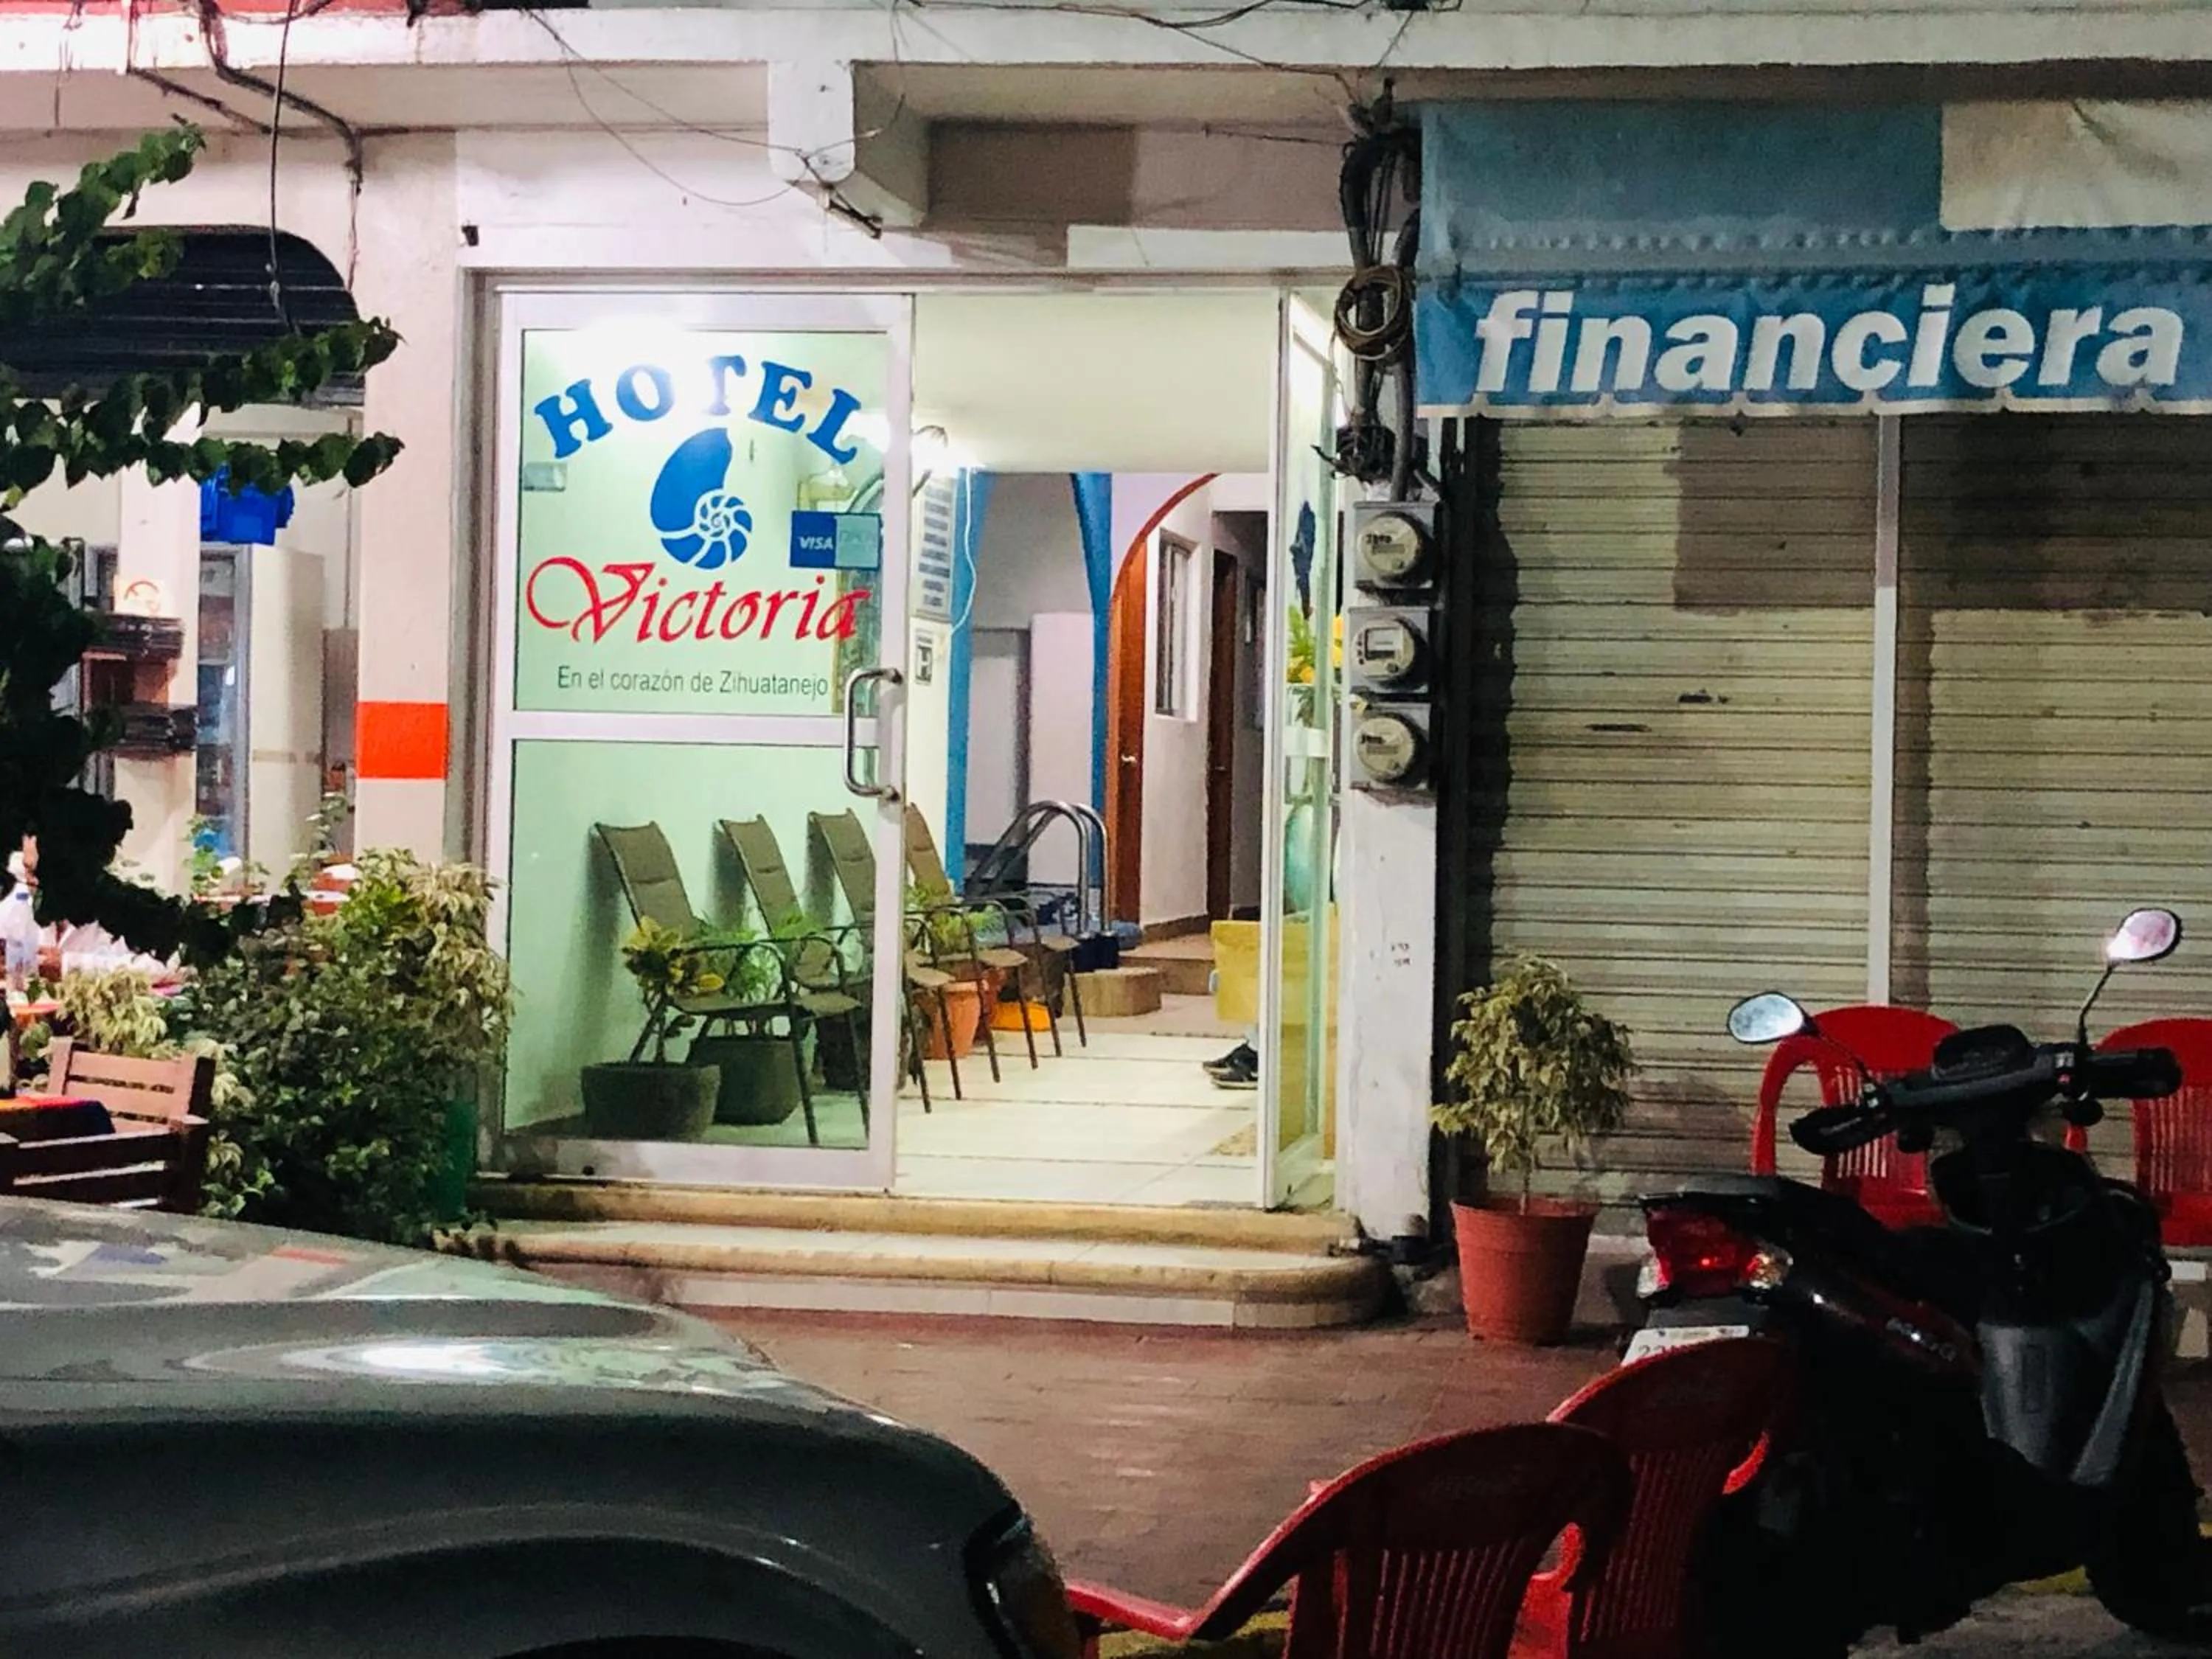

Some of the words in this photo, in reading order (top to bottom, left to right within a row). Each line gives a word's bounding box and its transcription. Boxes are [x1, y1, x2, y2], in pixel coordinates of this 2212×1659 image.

[1475, 283, 2185, 394] financiera
[533, 354, 862, 465] HOTEL
[798, 535, 834, 551] VISA
[526, 555, 872, 644] Victoria
[557, 665, 582, 689] En
[589, 668, 604, 689] el
[609, 667, 684, 692] corazón
[690, 670, 713, 693] de
[718, 669, 829, 701] Zihuatanejo
